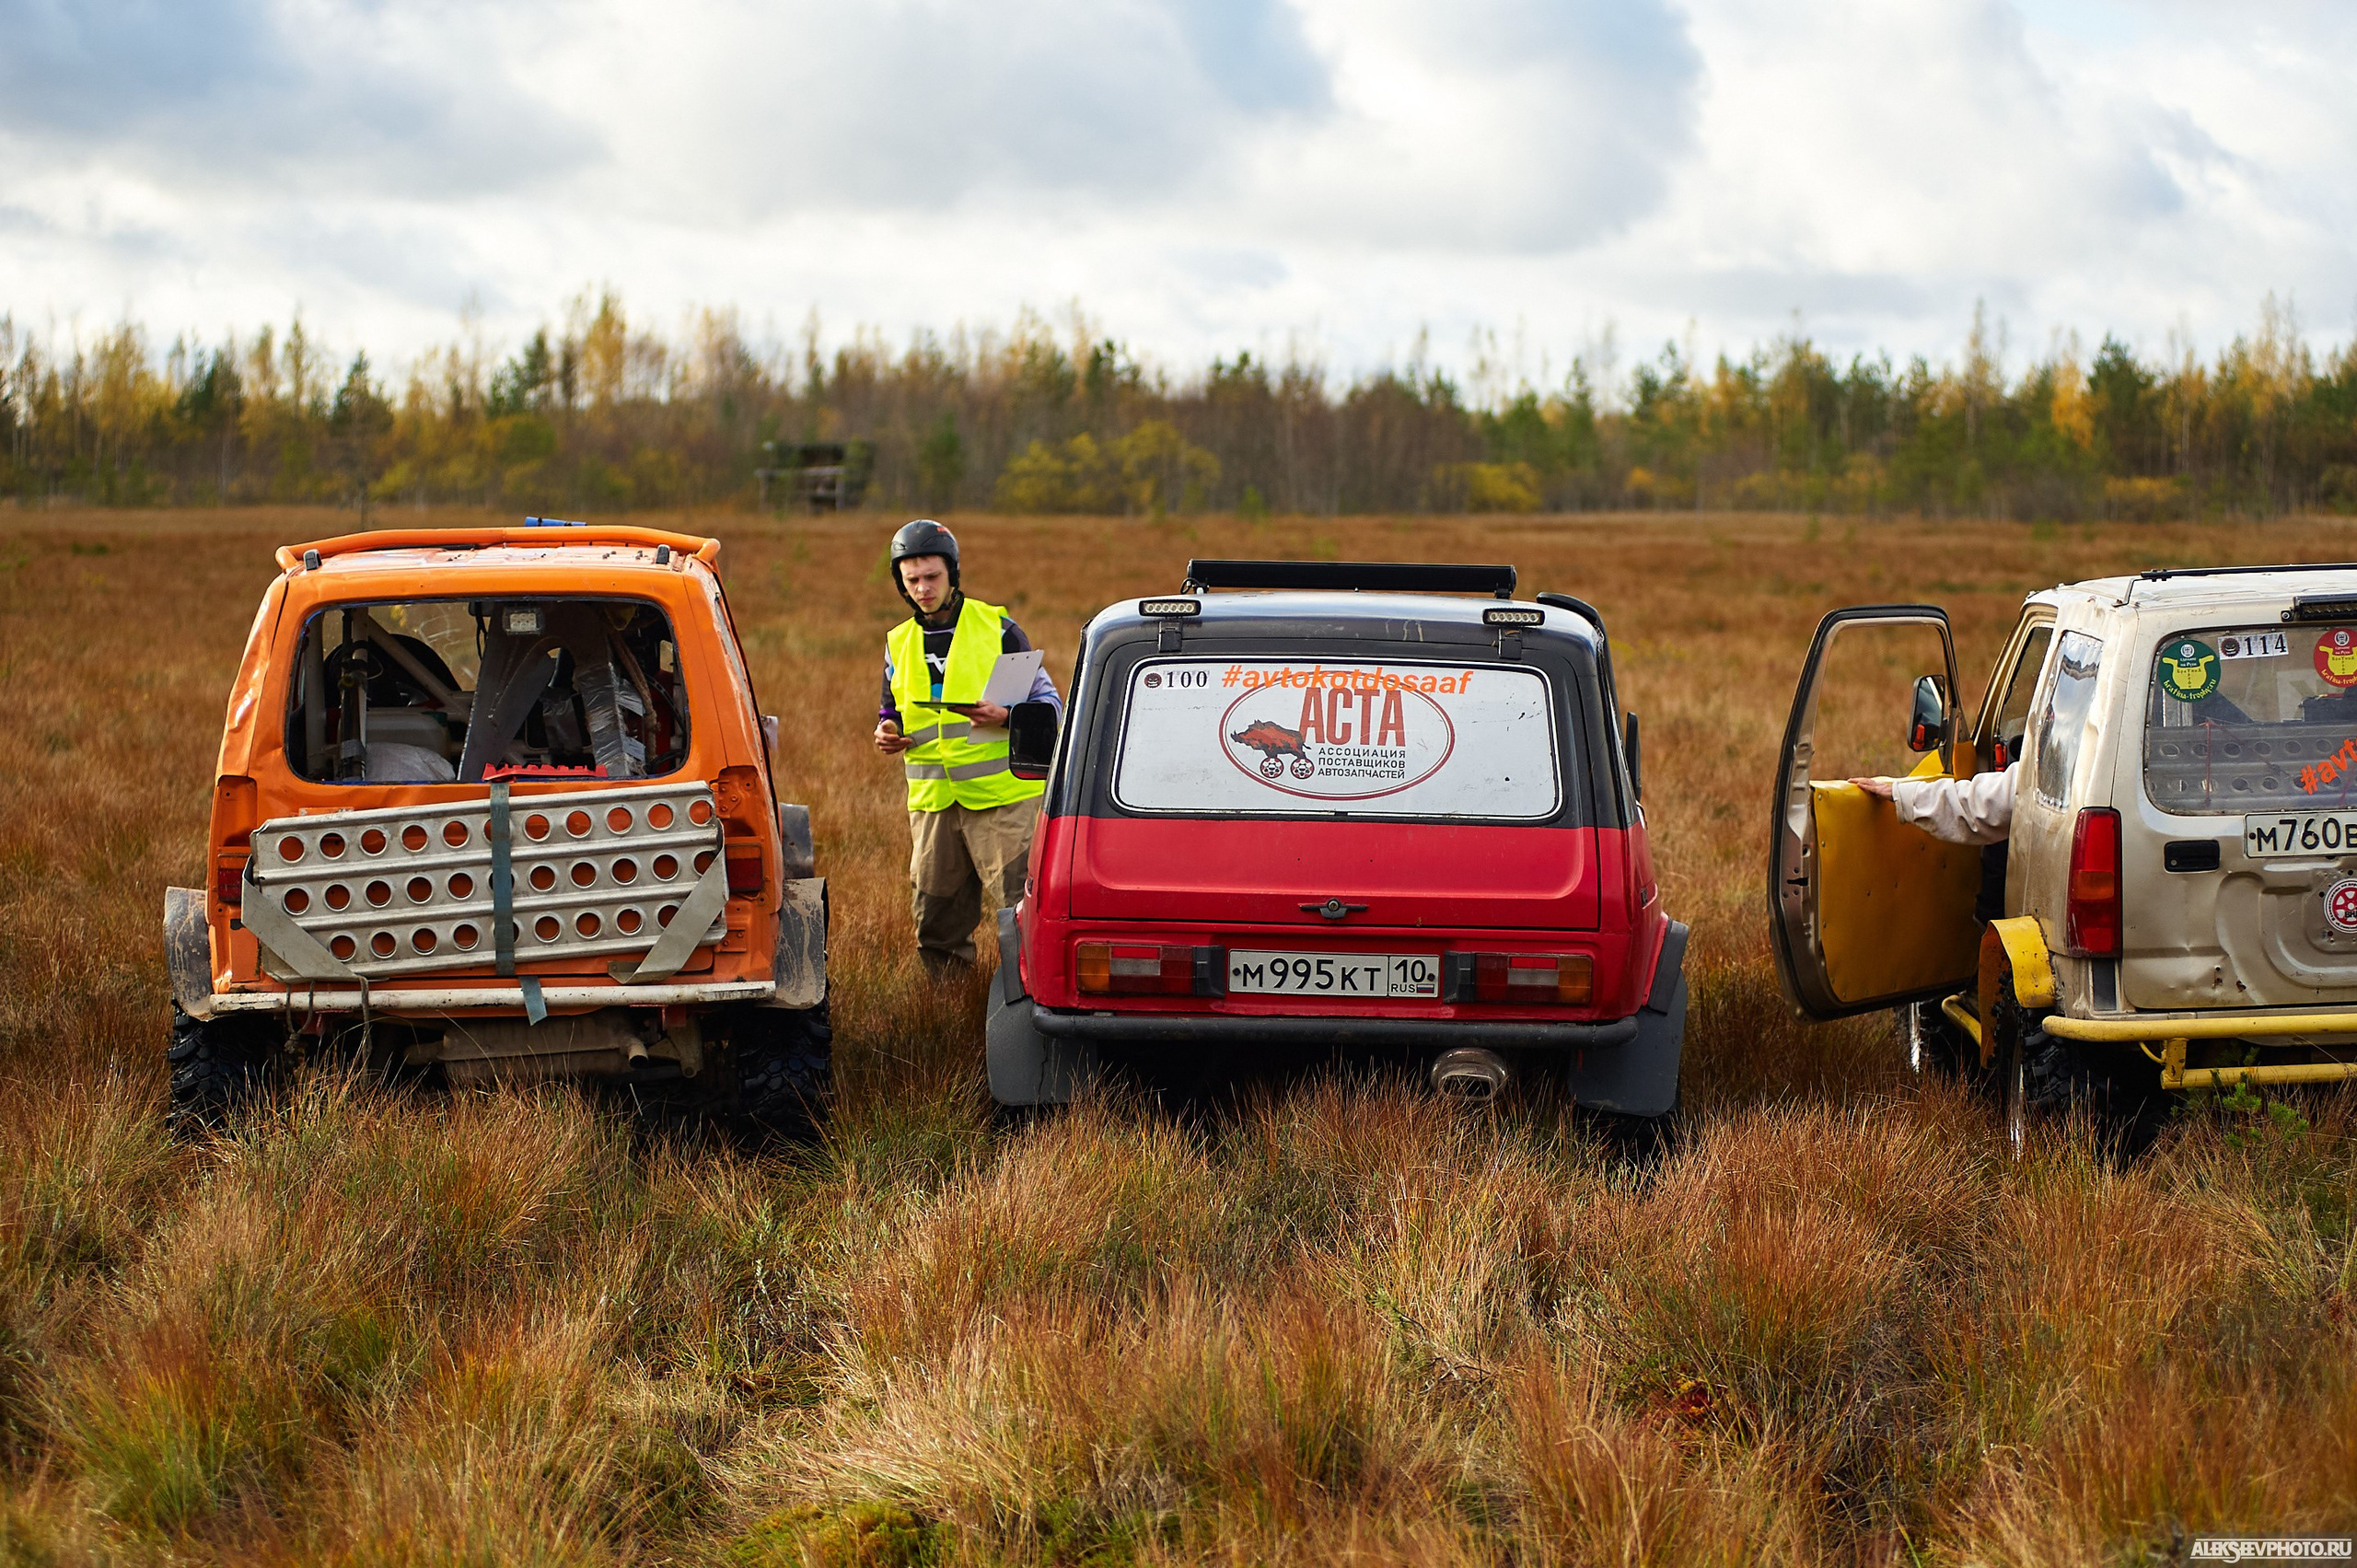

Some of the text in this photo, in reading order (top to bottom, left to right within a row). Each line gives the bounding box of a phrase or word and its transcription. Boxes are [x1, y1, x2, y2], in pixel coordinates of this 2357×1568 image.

[2244, 633, 2287, 656] 114
[1166, 670, 1209, 688] 100
[1221, 664, 1475, 695] #avtokotdosaaf
[1298, 686, 1406, 748] АСТА
[1318, 747, 1406, 759] АССОЦИАЦИЯ
[1318, 758, 1406, 769] ПОСТАВЩИКОВ
[1318, 768, 1405, 779] АВТОЗАПЧАСТЕЙ
[2300, 737, 2357, 796] #avt
[1242, 958, 1426, 992] М995КТ 10
[1390, 983, 1416, 993] RUS
